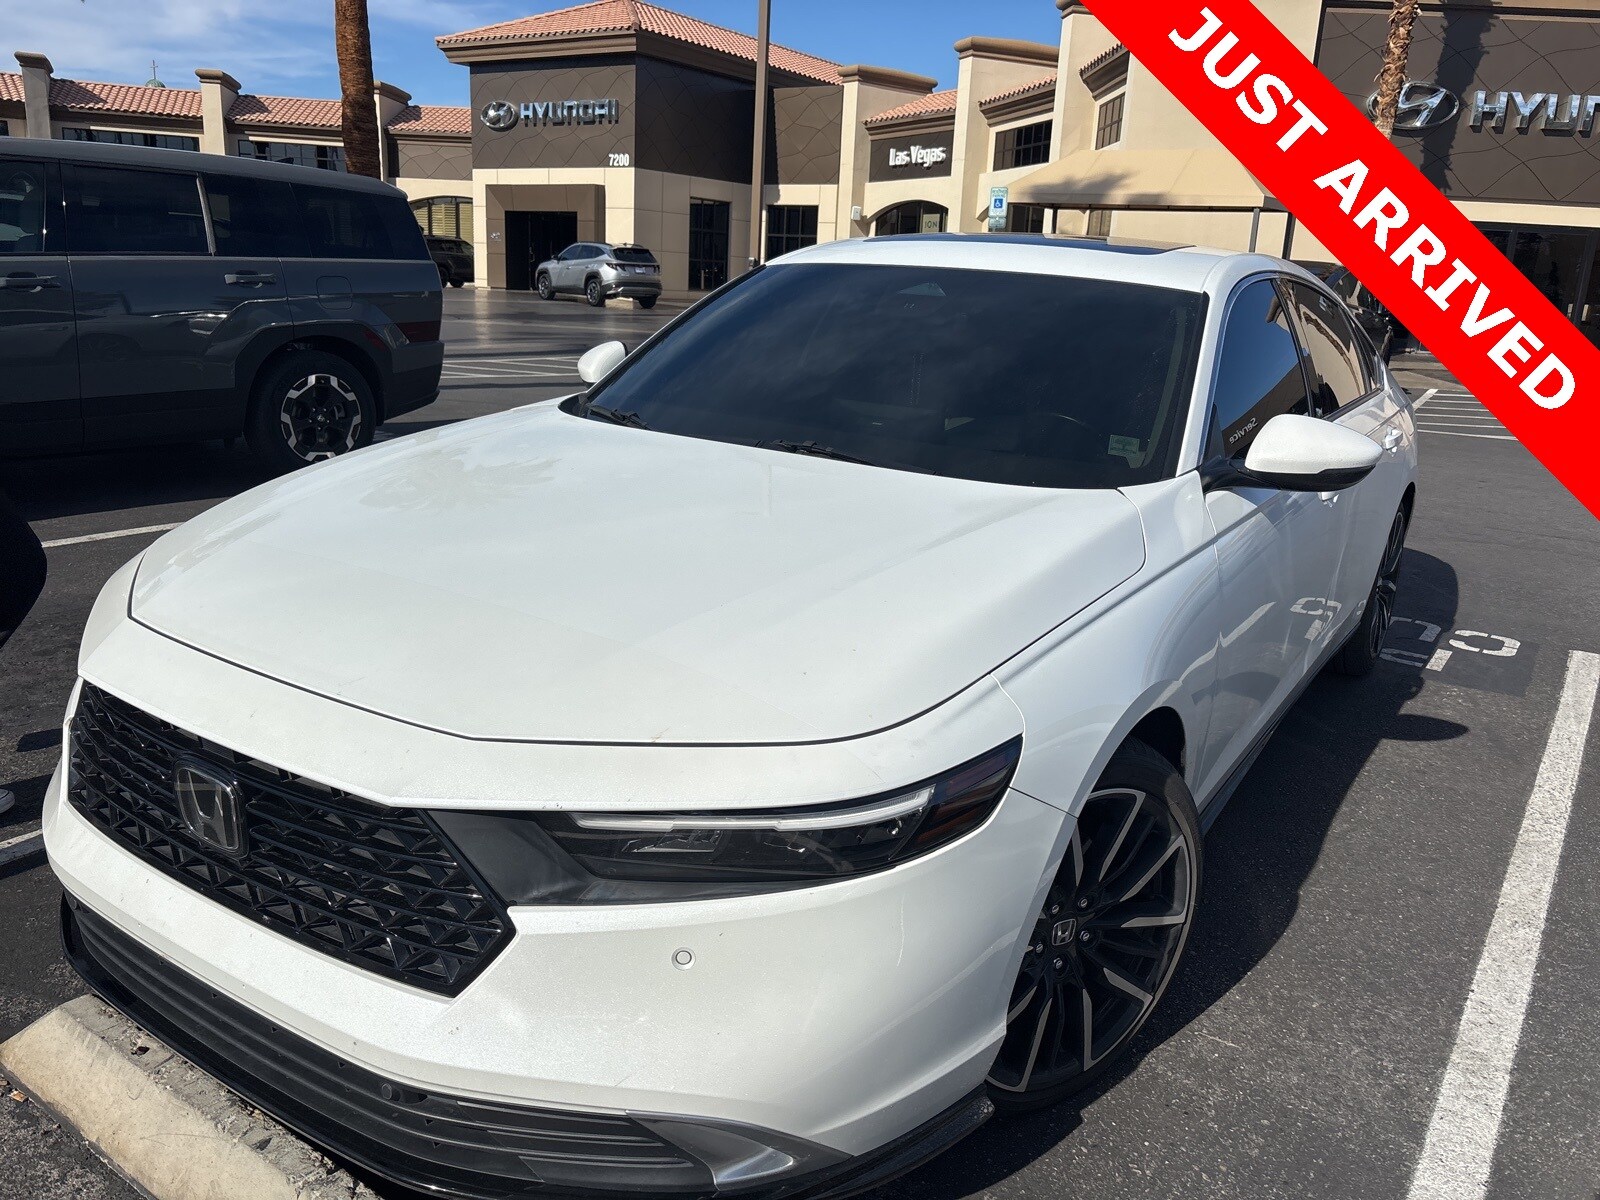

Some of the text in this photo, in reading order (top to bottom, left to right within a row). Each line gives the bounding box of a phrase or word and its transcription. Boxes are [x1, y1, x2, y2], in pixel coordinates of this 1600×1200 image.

[520, 99, 618, 124] HYUNDAI
[609, 153, 630, 167] 7200
[889, 145, 947, 168] Las Vegas
